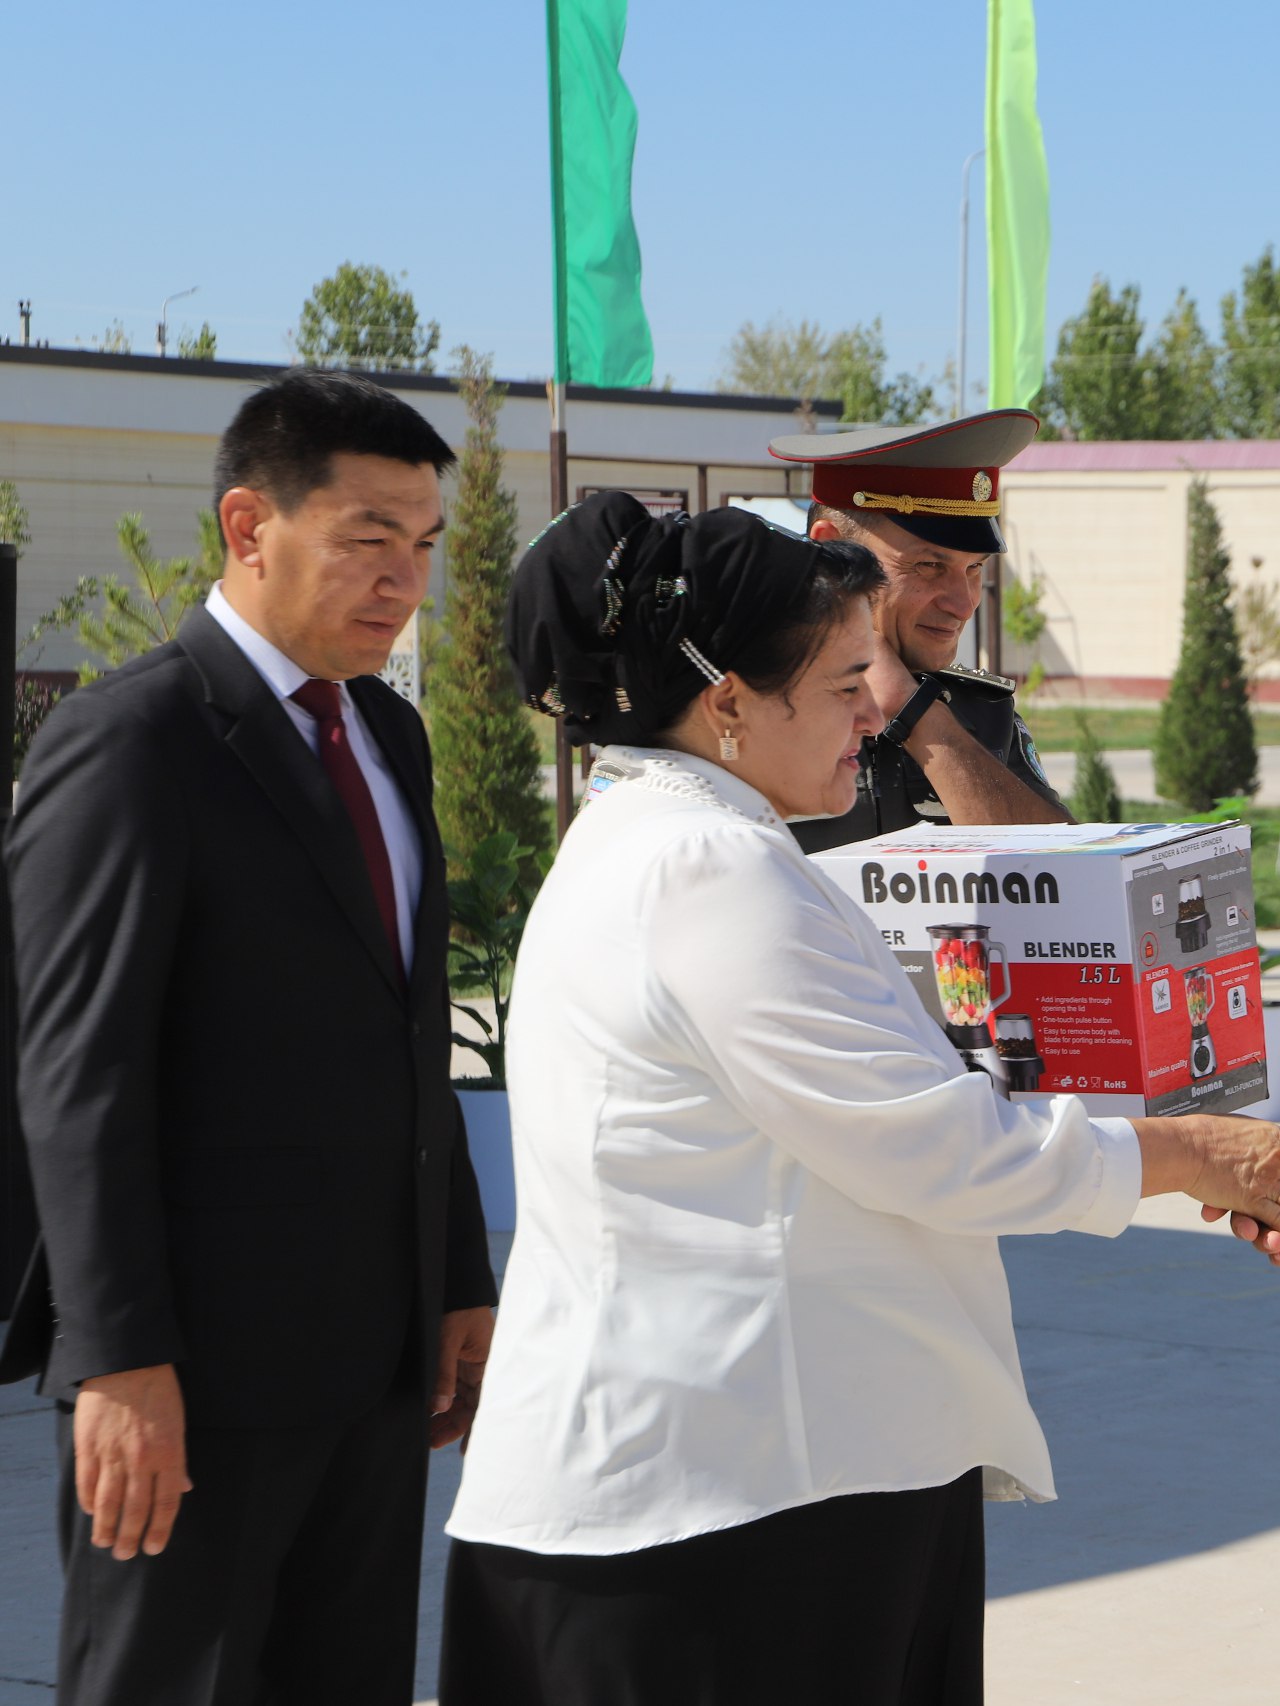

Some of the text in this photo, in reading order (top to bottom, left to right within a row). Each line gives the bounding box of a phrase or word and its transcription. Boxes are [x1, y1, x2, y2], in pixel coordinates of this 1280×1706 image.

[1151, 849, 1176, 861] BLENDER
[1181, 842, 1200, 853] COFFEE
[1201, 836, 1223, 848] GRINDER
[1214, 847, 1218, 856] 2
[1219, 845, 1226, 854] in
[861, 859, 1060, 904] Boinman
[1024, 942, 1117, 958] BLENDER
[1080, 966, 1121, 984] 1.5 L
[1146, 967, 1169, 981] BLENDER
[1055, 996, 1088, 1005] ingredients
[1088, 997, 1112, 1005] through
[1041, 1005, 1066, 1013] opening
[1043, 1028, 1059, 1036] Easy
[1091, 1028, 1106, 1036] body
[1106, 1037, 1133, 1046] cleaning
[1045, 1047, 1060, 1055] Easy
[1148, 1059, 1189, 1079] Maintain quality
[1104, 1080, 1127, 1089] RoHS
[1191, 1079, 1224, 1098] Boinman
[1224, 1076, 1264, 1096] MULTI-FUNCTION
